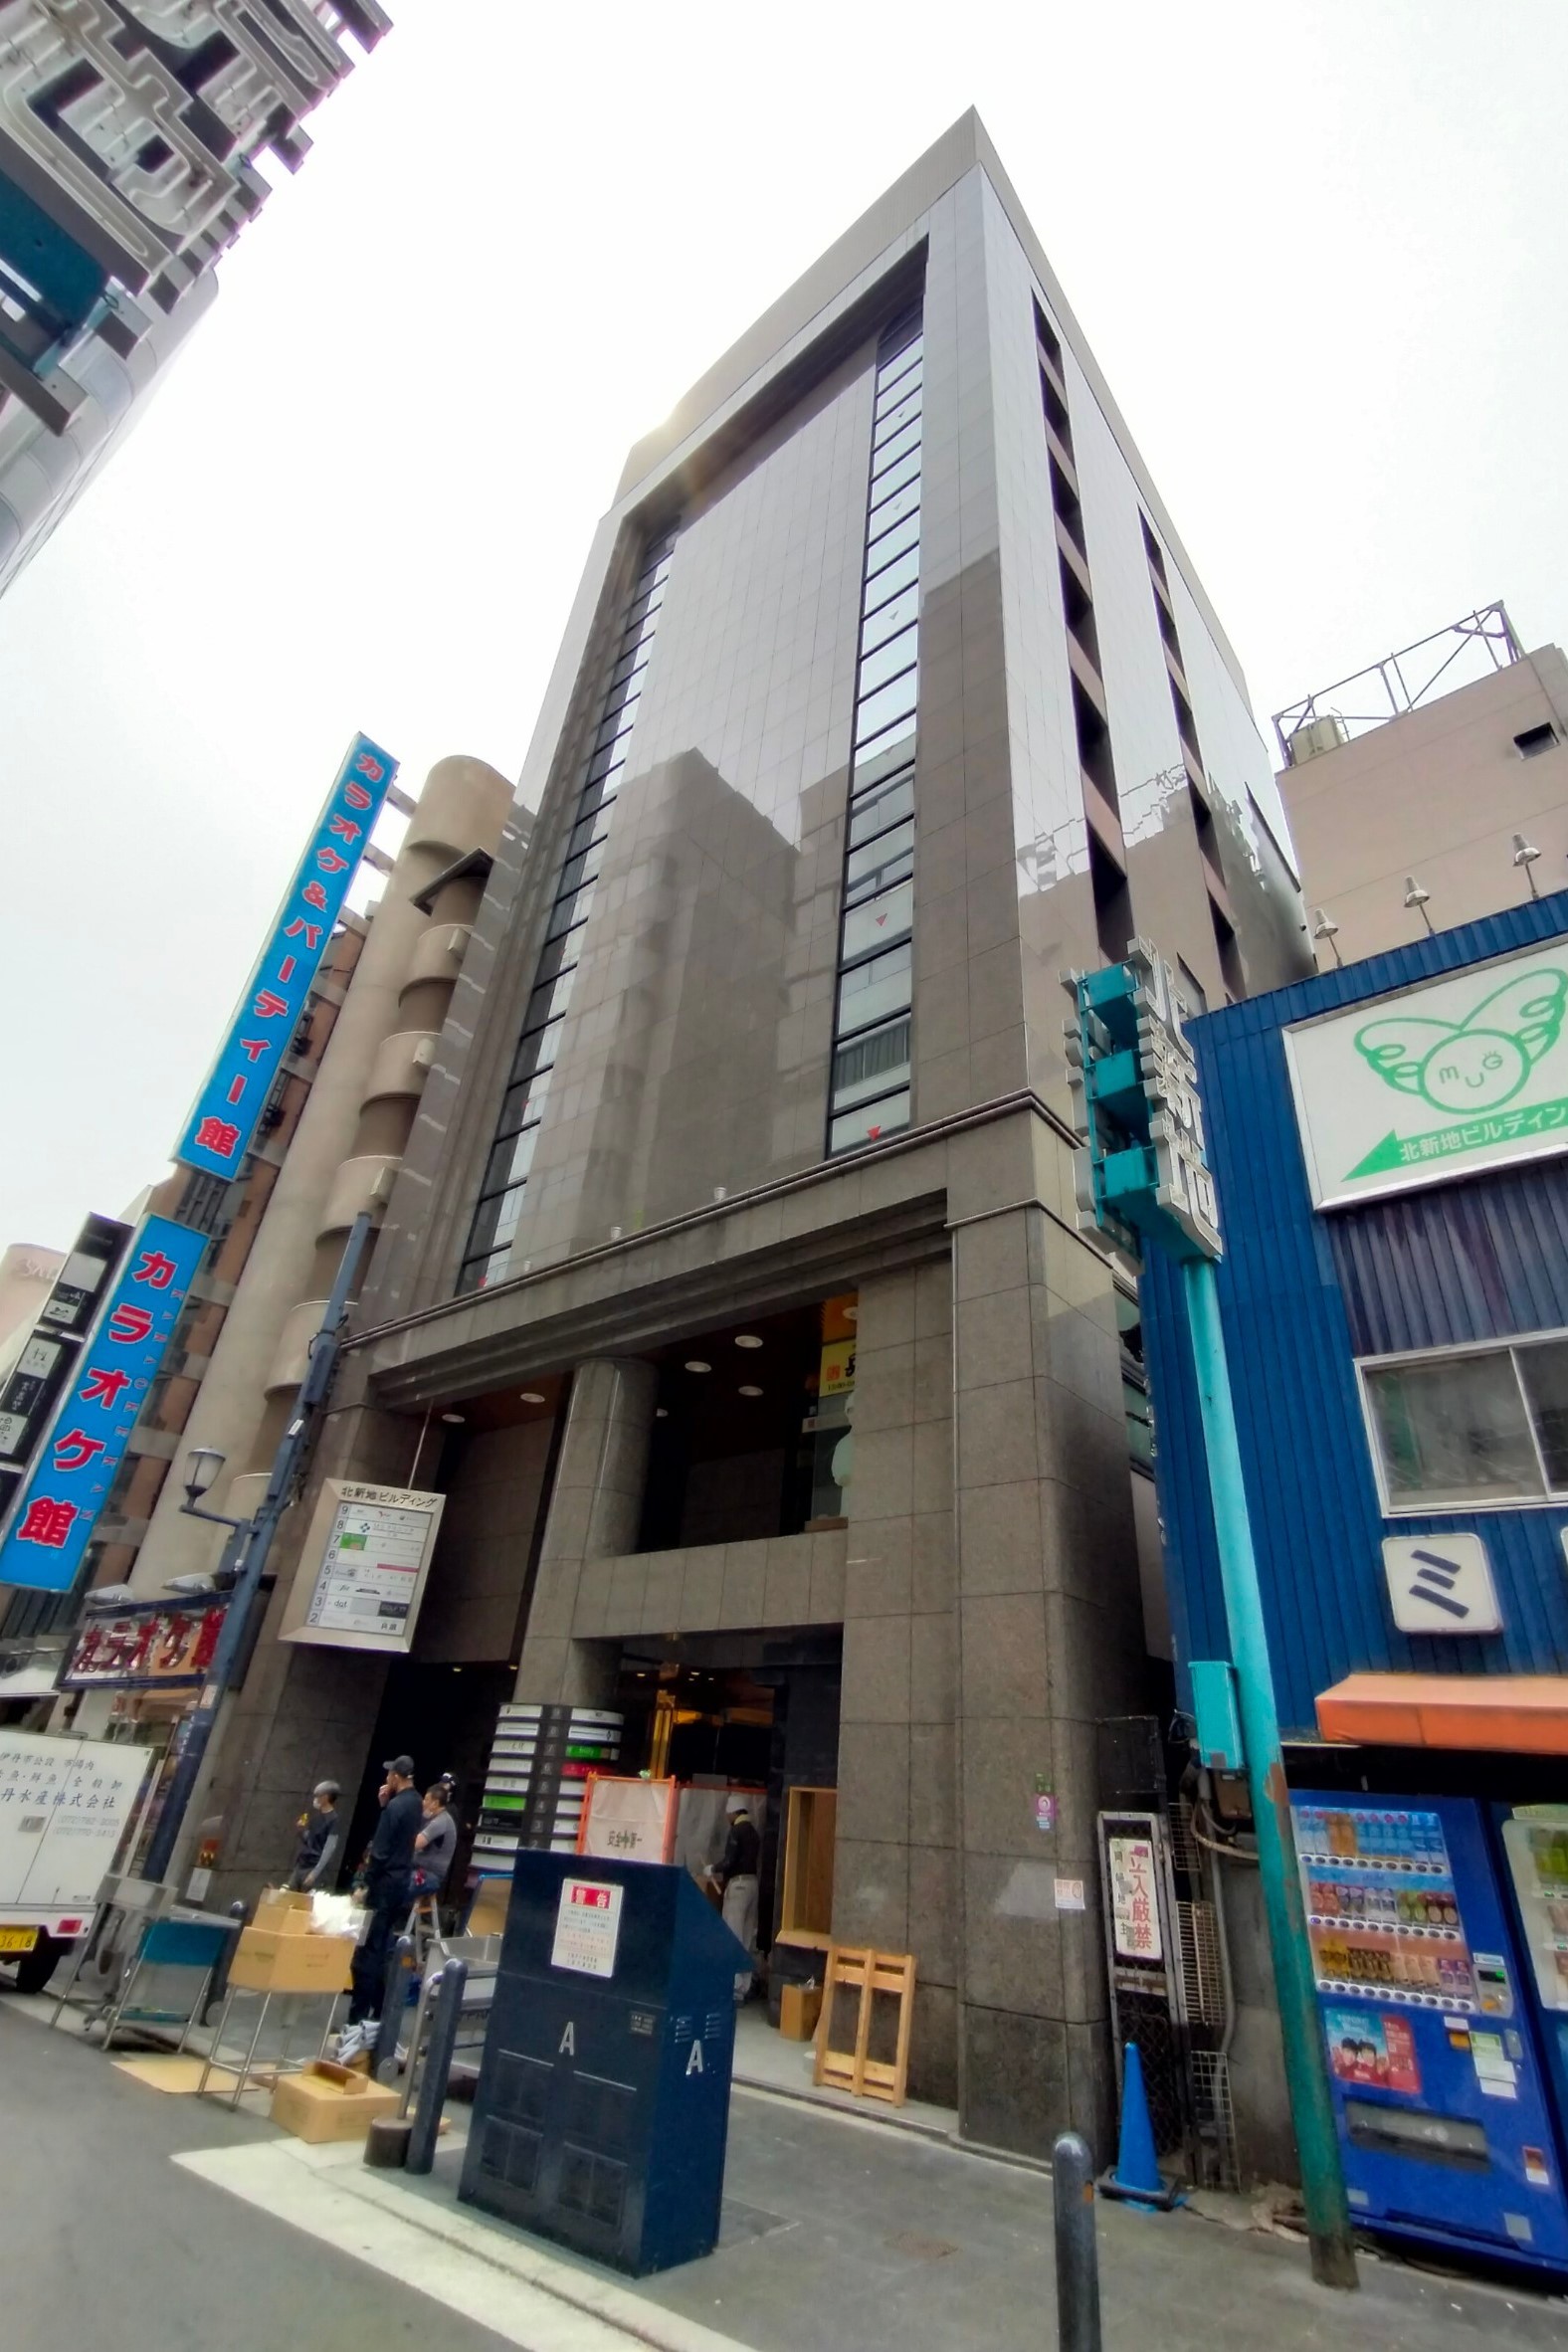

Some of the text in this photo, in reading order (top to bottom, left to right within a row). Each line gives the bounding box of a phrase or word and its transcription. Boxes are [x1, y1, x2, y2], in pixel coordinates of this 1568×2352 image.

[194, 752, 385, 1158] カラオケ&パーティー館
[1400, 1106, 1566, 1162] 北新地ビルディン
[16, 1250, 178, 1549] カラオケ館
[341, 1485, 438, 1507] 北新地ビルディング
[342, 1505, 348, 1515] 9
[336, 1520, 344, 1529] 8
[328, 1550, 335, 1559] 6
[324, 1565, 331, 1575] 5
[319, 1581, 327, 1591] 4
[314, 1597, 322, 1607] 3
[309, 1613, 318, 1623] 2
[558, 2021, 575, 2057] A
[686, 2040, 704, 2075] A
